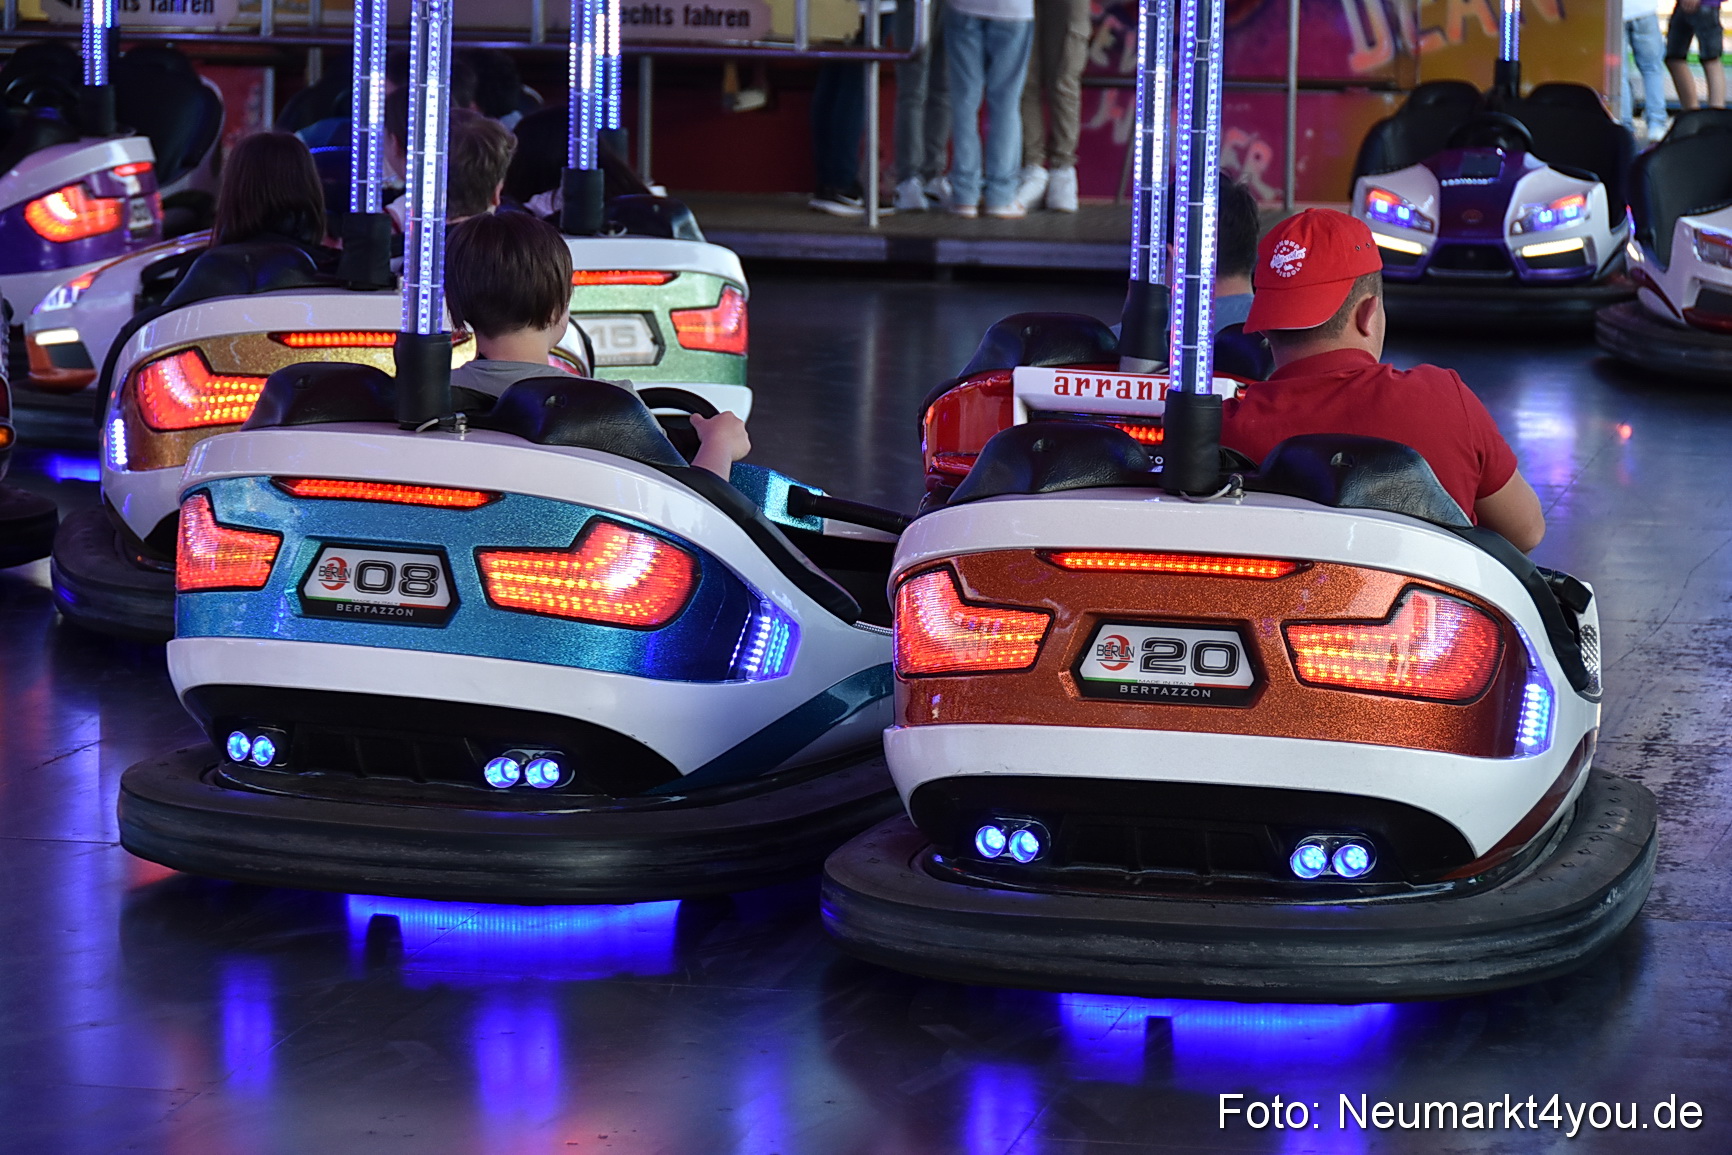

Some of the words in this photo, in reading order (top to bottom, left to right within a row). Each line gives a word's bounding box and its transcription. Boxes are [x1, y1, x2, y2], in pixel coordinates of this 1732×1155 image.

[620, 4, 674, 26] echts
[683, 5, 750, 27] fahren
[318, 565, 352, 579] BERLIN
[354, 559, 440, 599] 08
[336, 603, 414, 617] BERTAZZON
[1096, 644, 1135, 658] BERLIN
[1139, 637, 1240, 678] 20
[1119, 684, 1212, 698] BERTAZZON
